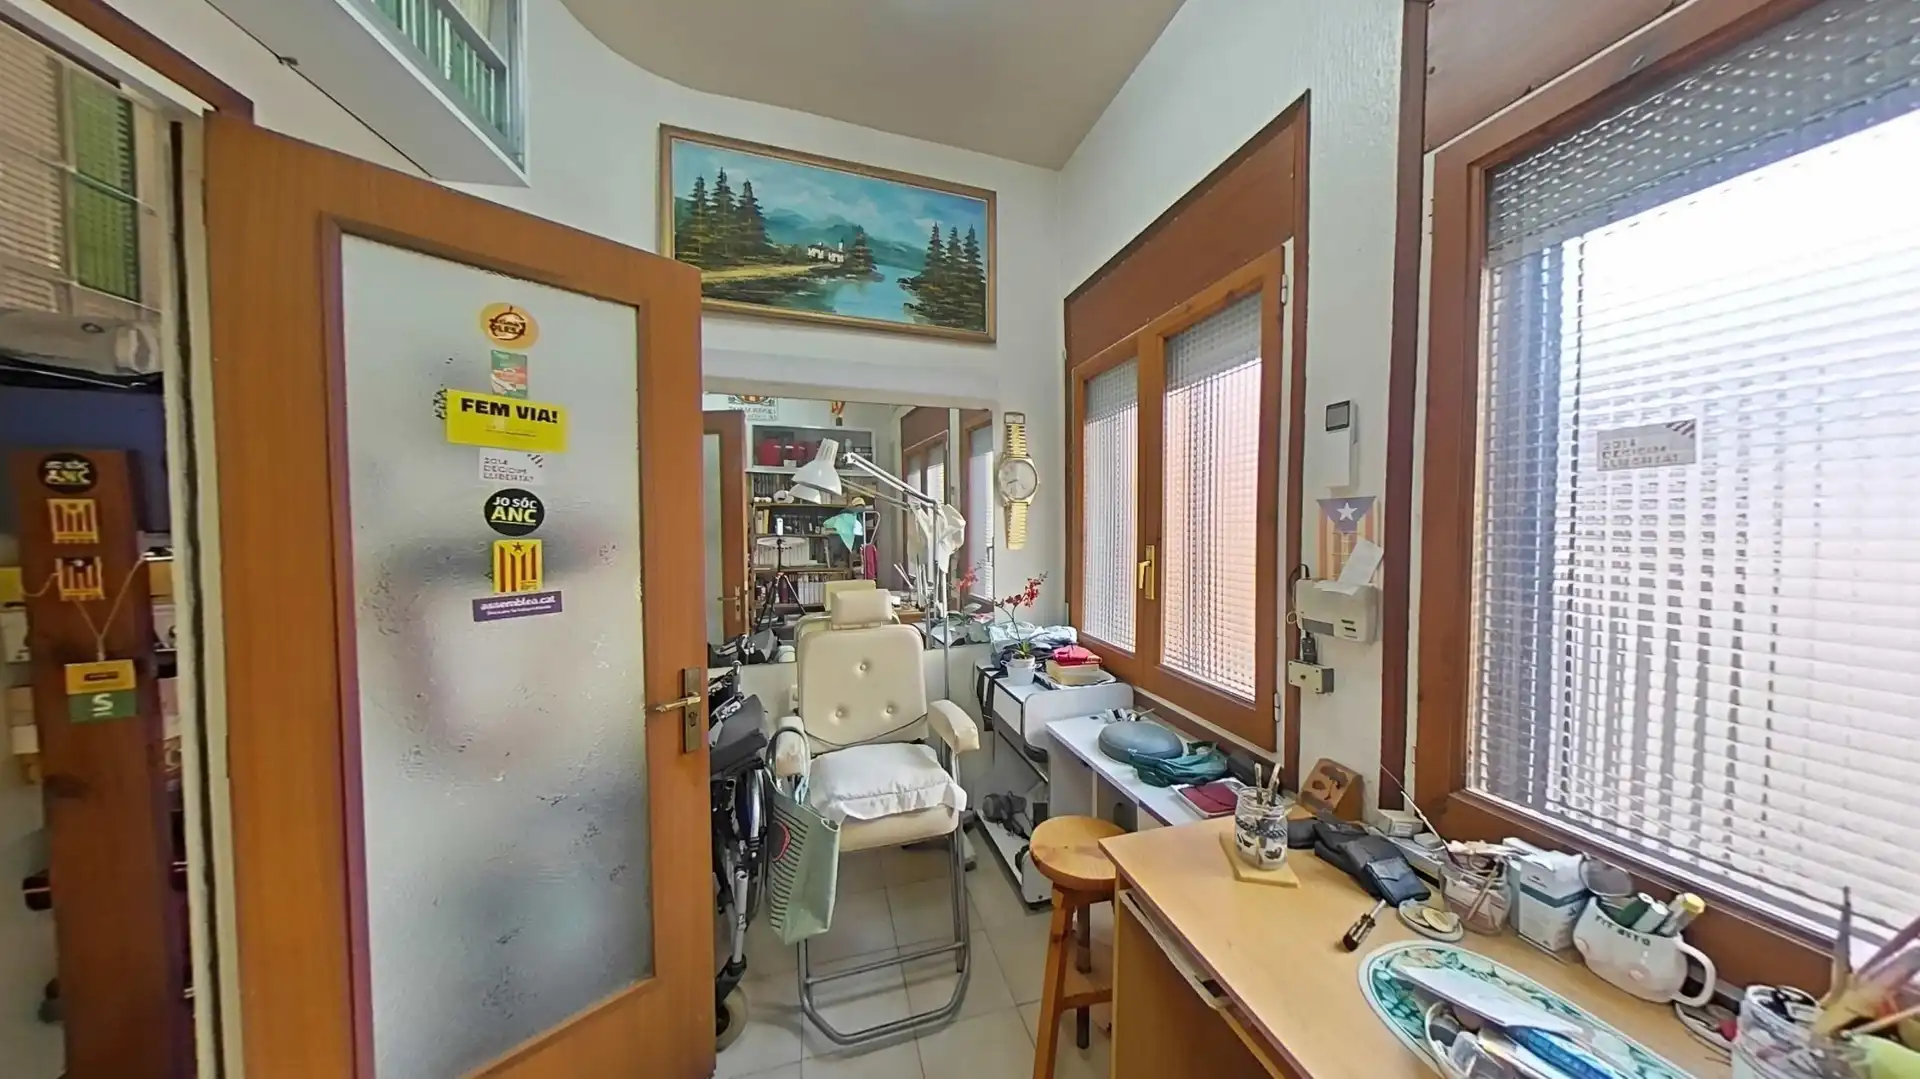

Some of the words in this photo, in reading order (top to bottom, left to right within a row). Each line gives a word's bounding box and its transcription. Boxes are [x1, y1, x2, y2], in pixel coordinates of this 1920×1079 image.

[461, 398, 510, 417] FEM
[516, 405, 558, 424] VIA!
[492, 497, 510, 507] JO
[512, 497, 537, 509] SÓC
[491, 506, 537, 523] ANC
